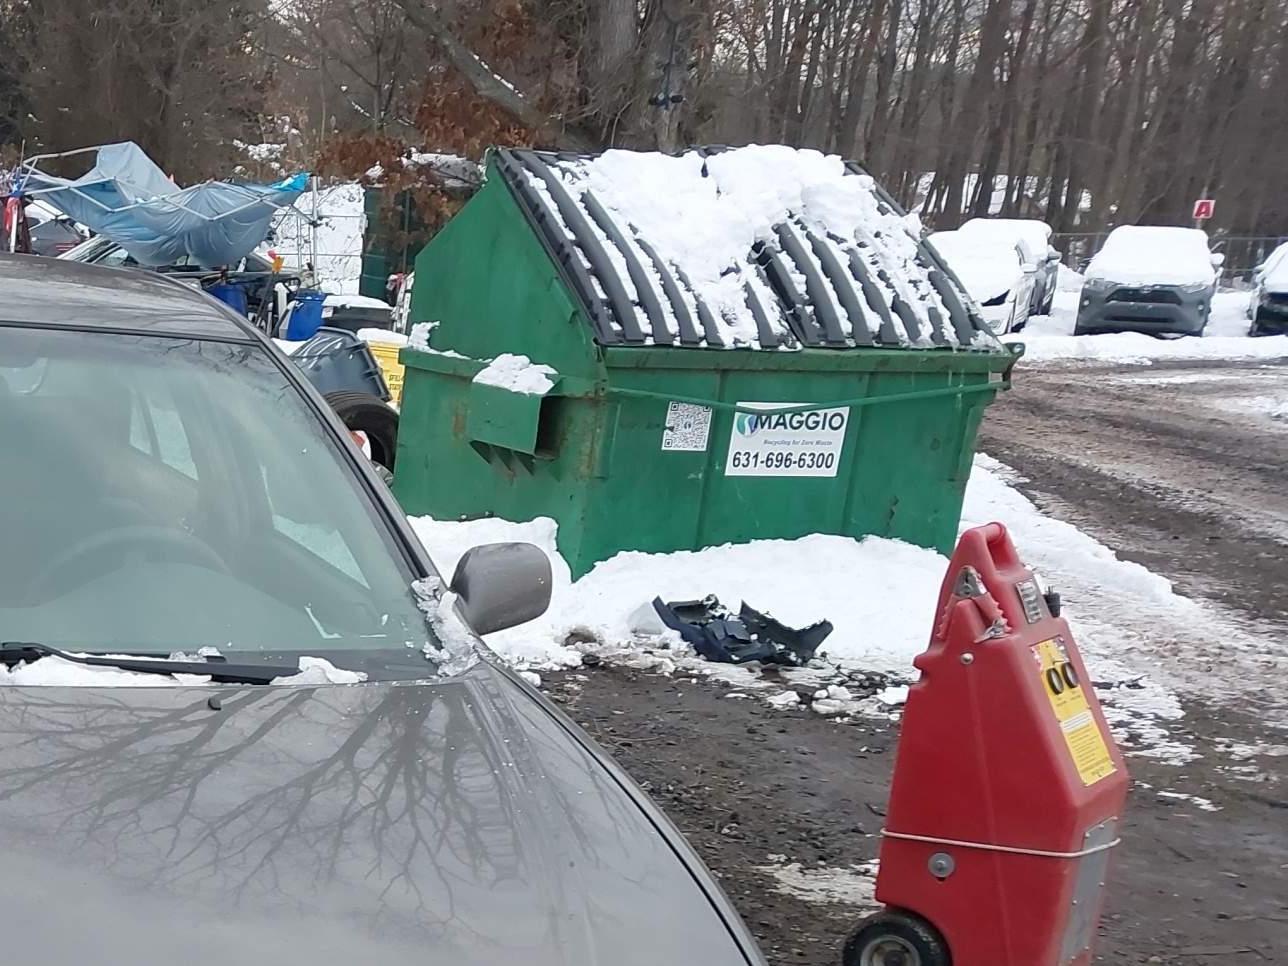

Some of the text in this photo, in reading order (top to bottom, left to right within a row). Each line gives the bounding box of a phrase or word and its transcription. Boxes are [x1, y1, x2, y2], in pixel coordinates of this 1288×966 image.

[1195, 201, 1211, 217] A
[753, 411, 845, 431] MAGGIO
[732, 451, 834, 469] 631-696-6300
